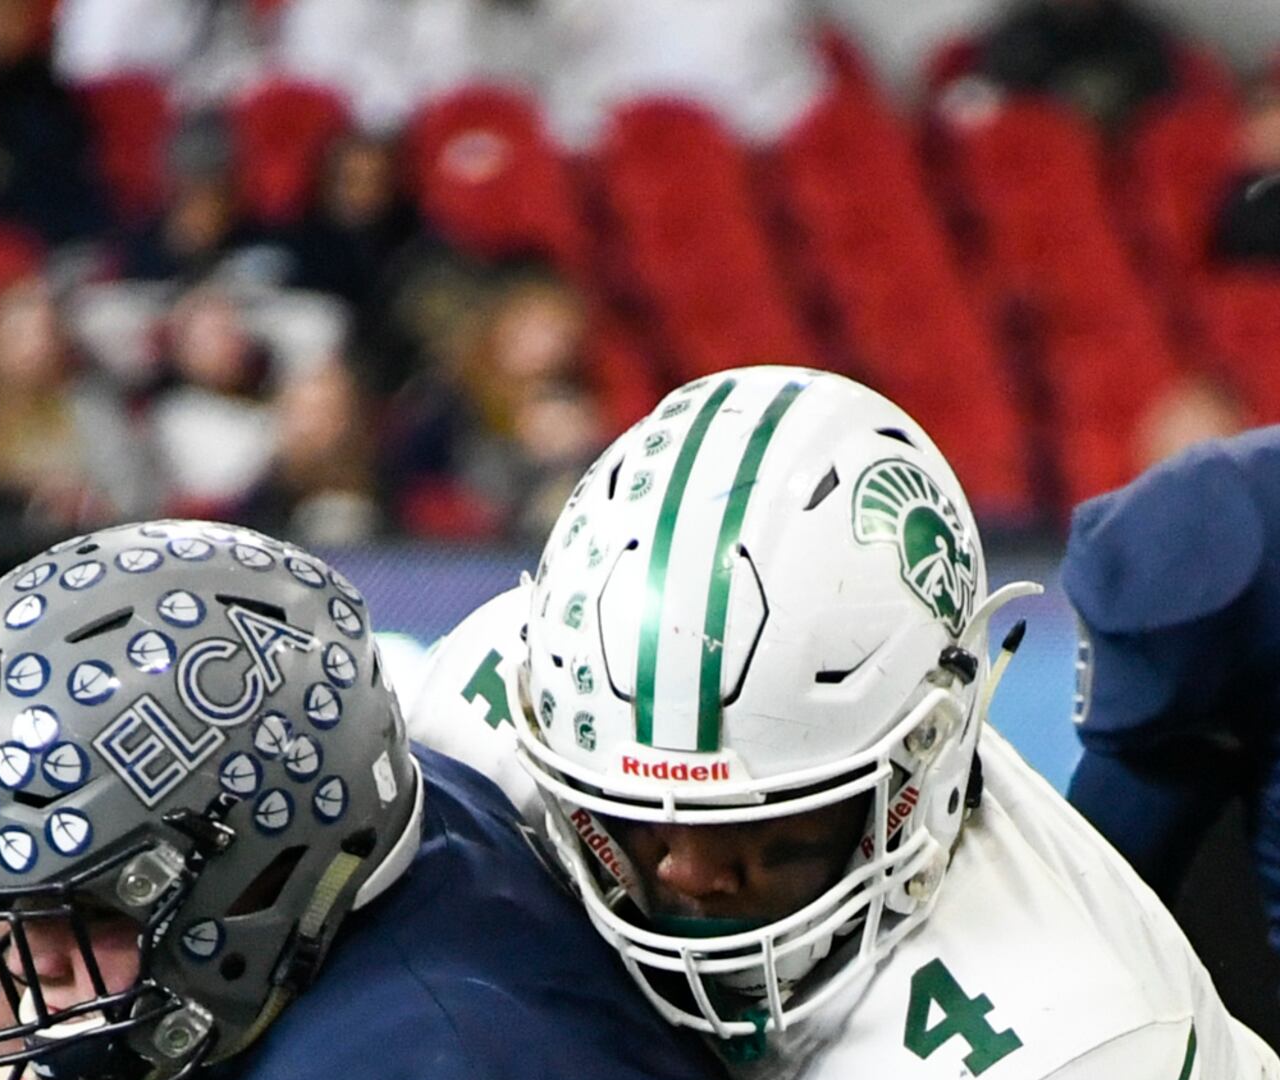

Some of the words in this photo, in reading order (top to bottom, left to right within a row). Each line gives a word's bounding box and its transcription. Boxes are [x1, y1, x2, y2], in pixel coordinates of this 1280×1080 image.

[91, 603, 319, 809] ELCA
[621, 755, 731, 781] Riddell
[903, 957, 1024, 1078] 4
